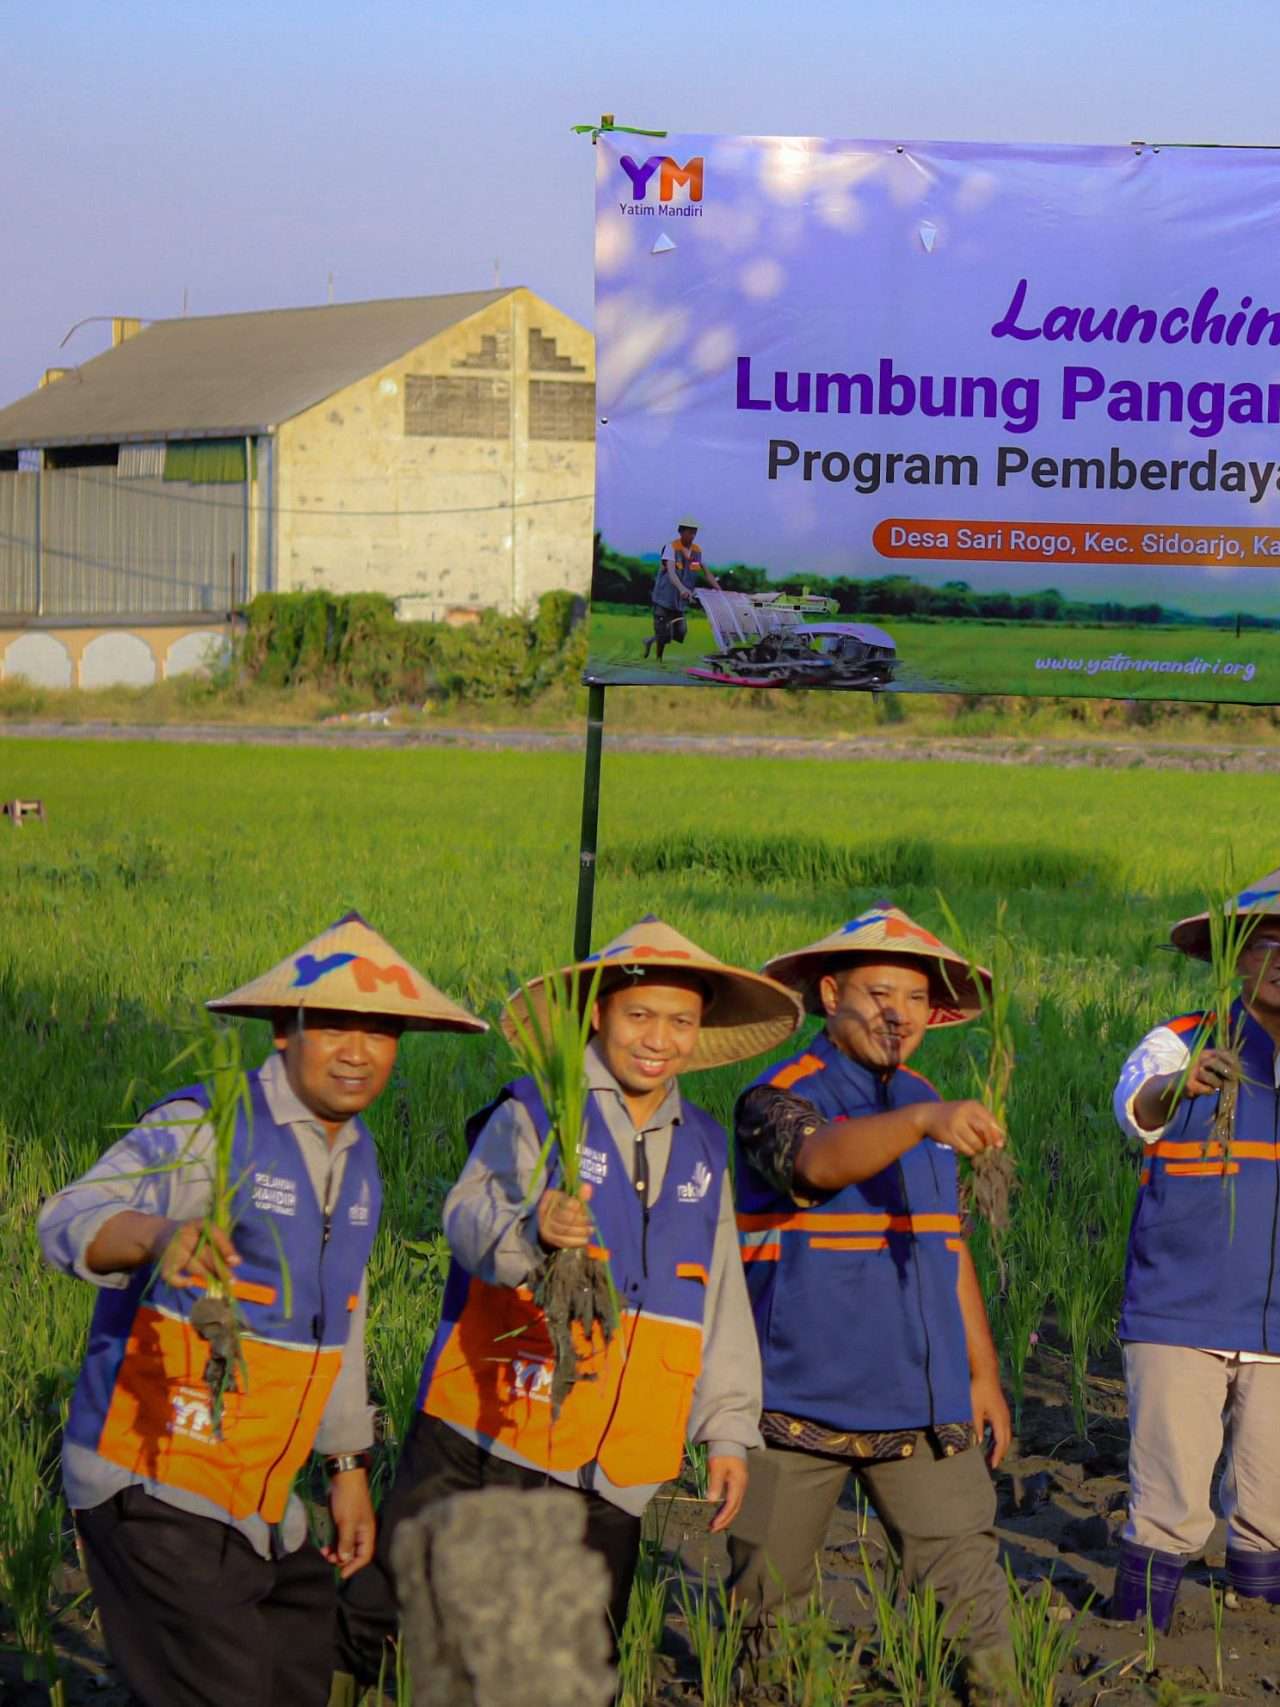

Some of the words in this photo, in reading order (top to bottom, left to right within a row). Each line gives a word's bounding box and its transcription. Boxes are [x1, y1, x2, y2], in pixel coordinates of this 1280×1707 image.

[619, 155, 704, 202] YM
[619, 203, 655, 215] Yatim
[658, 204, 703, 217] Mandiri
[736, 356, 1040, 434] Lumbung
[768, 439, 978, 494] Program
[890, 527, 949, 548] Desa
[957, 529, 1002, 550] Sari
[1010, 531, 1076, 556] Rogo,
[1085, 532, 1134, 552] Kec.
[1142, 533, 1246, 560] Sidoarjo,
[1035, 653, 1256, 682] www.yatimmandiri.org
